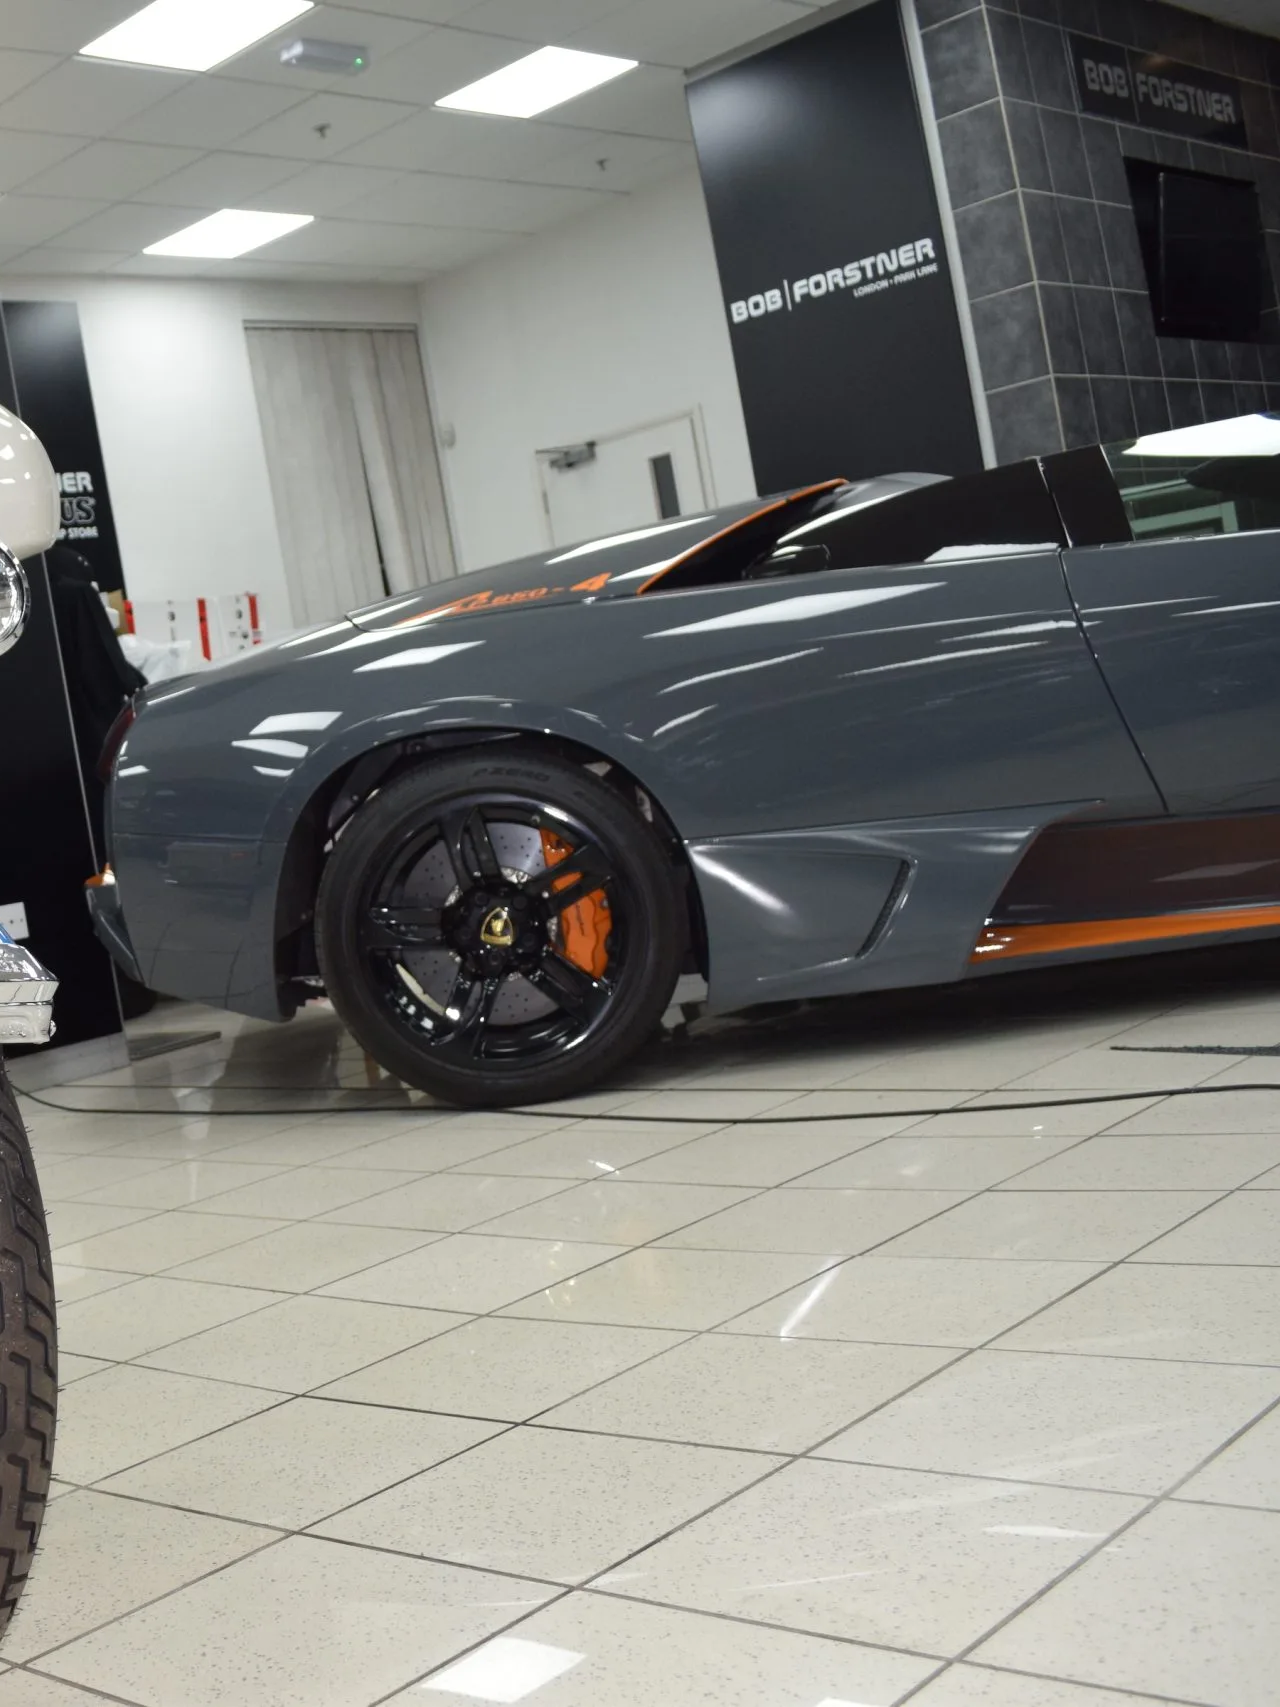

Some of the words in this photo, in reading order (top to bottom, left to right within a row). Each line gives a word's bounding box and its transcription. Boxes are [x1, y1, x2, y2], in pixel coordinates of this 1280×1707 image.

[1083, 58, 1129, 98] BOB
[1135, 72, 1236, 124] FORSTNER
[730, 288, 783, 324] BOB
[792, 237, 936, 303] FORSTNER
